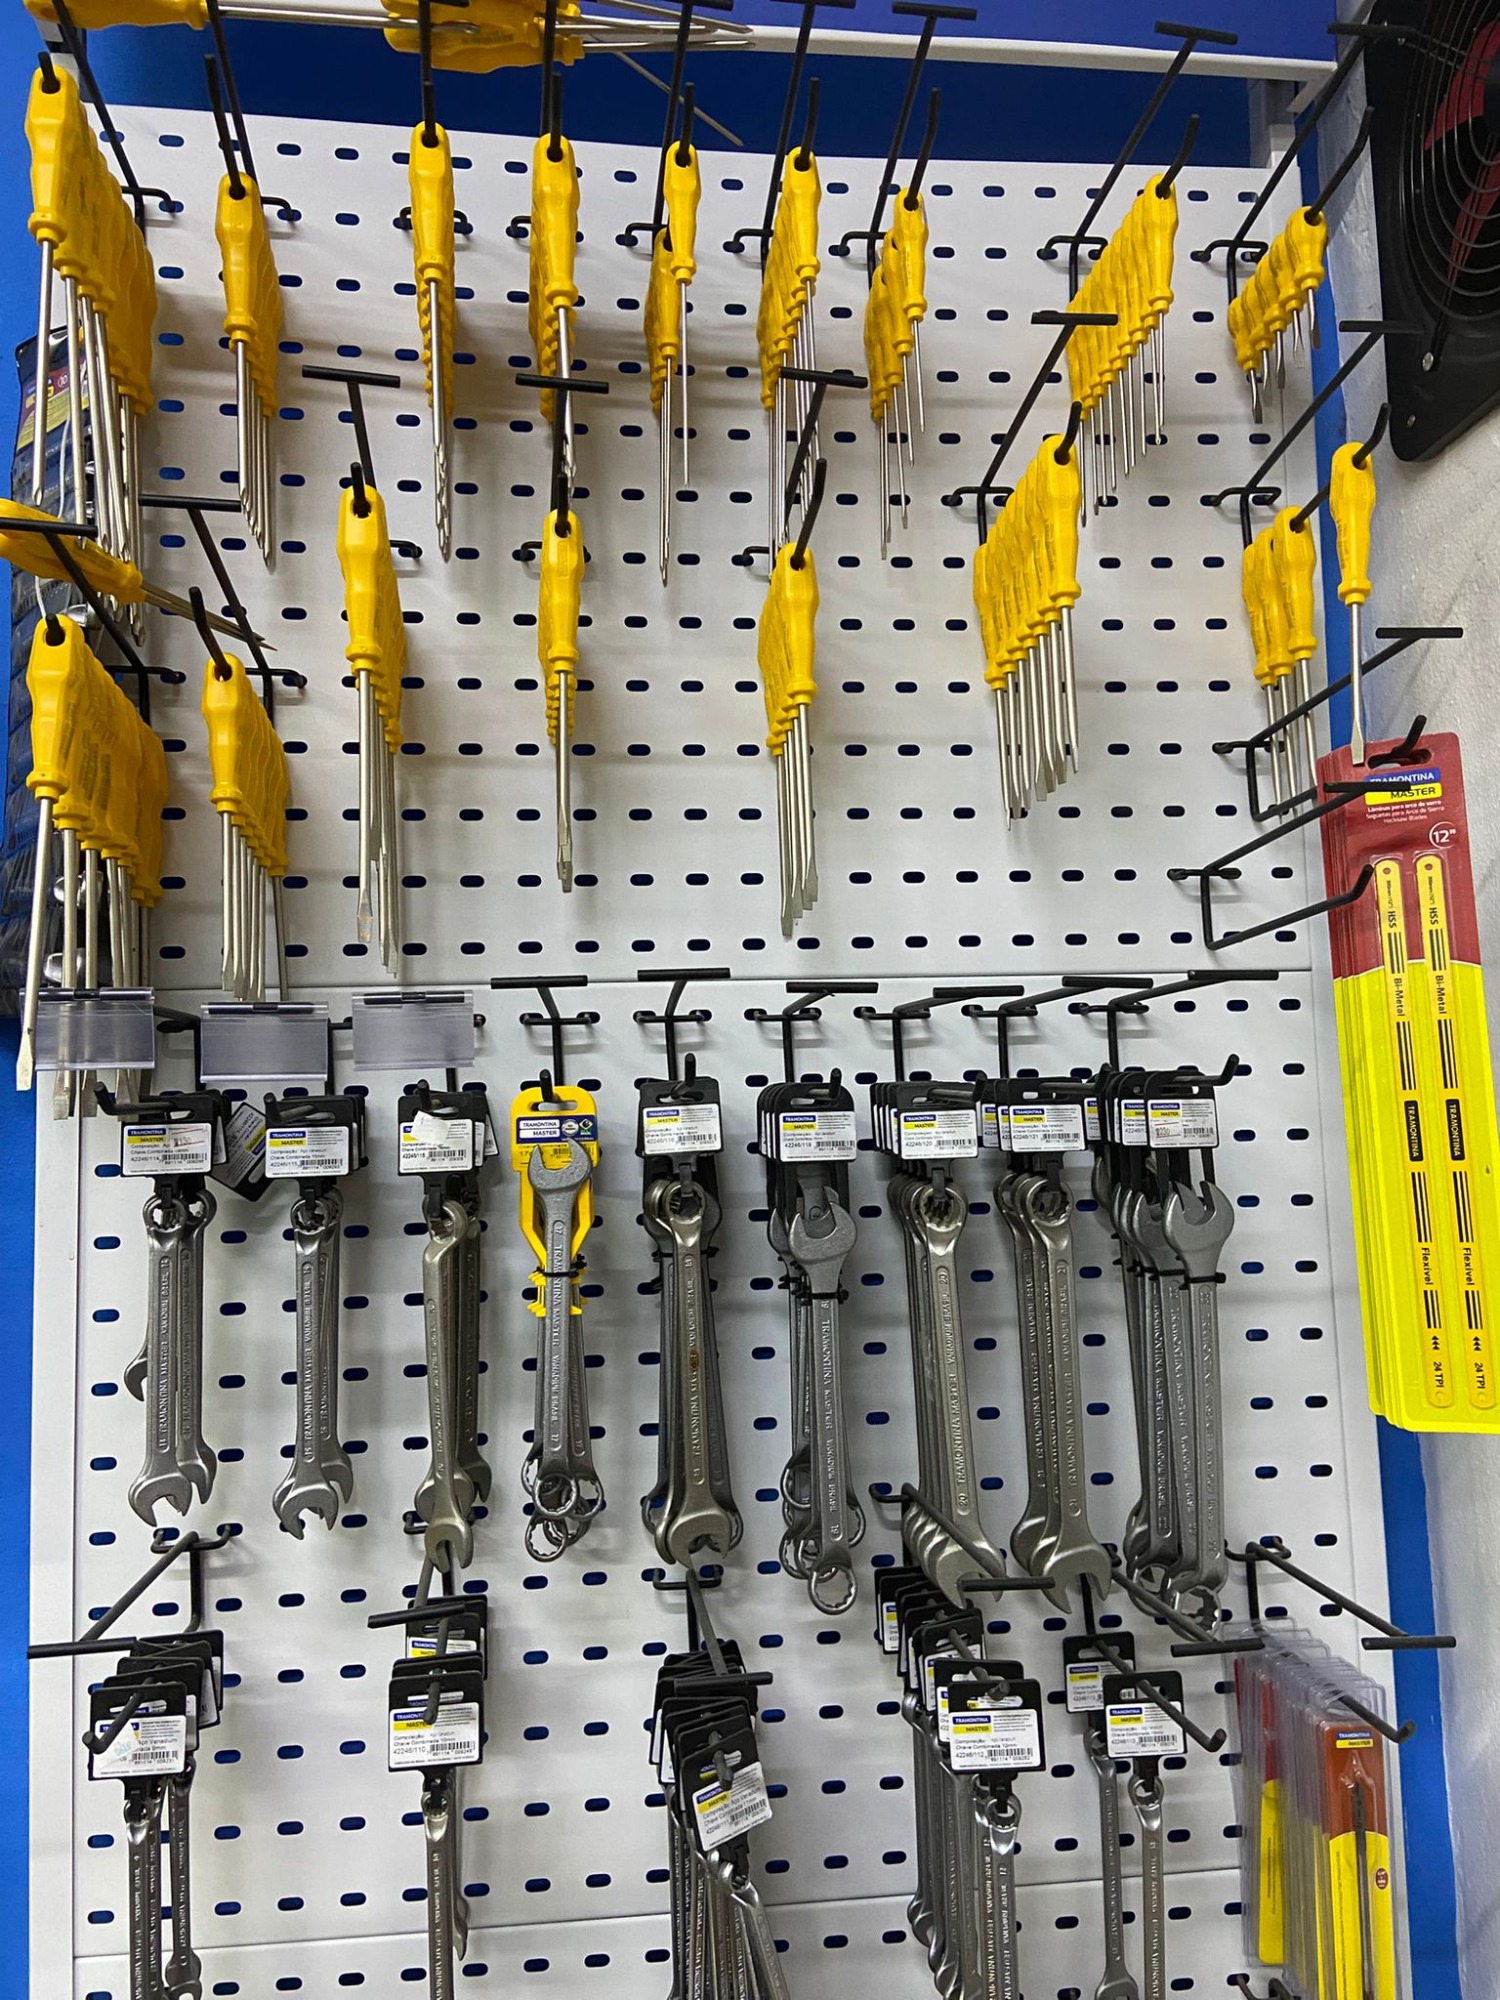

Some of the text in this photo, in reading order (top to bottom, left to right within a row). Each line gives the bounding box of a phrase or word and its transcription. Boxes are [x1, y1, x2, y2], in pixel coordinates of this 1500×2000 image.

[1387, 911, 1397, 928] HSS
[1429, 907, 1439, 925] HSS
[1394, 977, 1405, 1017] Bi-Metal
[1435, 975, 1447, 1014] Bi-Metal
[1408, 1105, 1419, 1157] TRAMONTINA
[1449, 1104, 1461, 1156] TRAMONTINA
[938, 1271, 948, 1286] 20
[1421, 1247, 1434, 1286] Flexível
[1463, 1247, 1475, 1286] Flexível
[821, 1320, 832, 1385] TRAMONTINA
[948, 1373, 959, 1415] MASTER
[1433, 1361, 1445, 1388] 24 TPI
[1474, 1362, 1486, 1389] 24 TPI
[951, 1417, 966, 1486] TRAMONTINA
[958, 1492, 968, 1507] 20
[708, 1794, 728, 1807] MASTER
[704, 1816, 718, 1826] Chave
